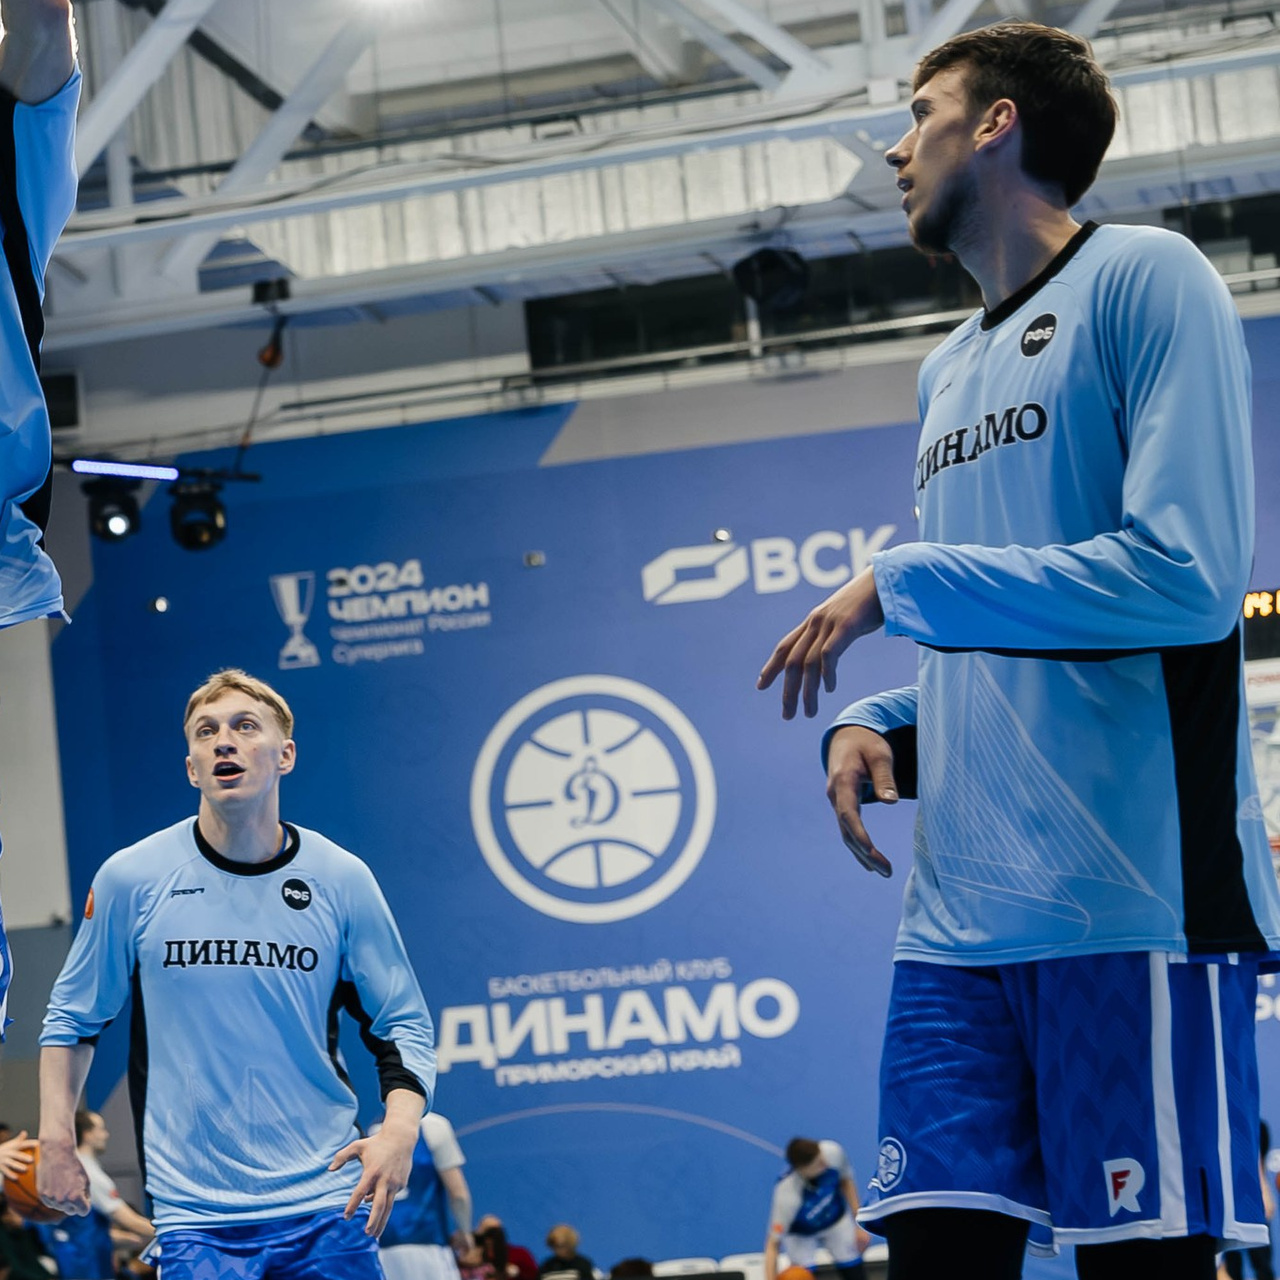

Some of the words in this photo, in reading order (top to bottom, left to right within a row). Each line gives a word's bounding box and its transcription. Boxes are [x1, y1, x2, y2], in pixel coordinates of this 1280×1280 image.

[326, 559, 424, 597] 2024
[753, 524, 897, 596] ВСК
[327, 581, 490, 623] ЧЕМПИОН
[284, 887, 310, 902] РФБ
[163, 938, 319, 973] ДИНАМО
[676, 956, 733, 981] КЛУБ
[436, 977, 800, 1074] ДИНАМО
[495, 1048, 668, 1088] ПРИМОРСКИЙ
[670, 1043, 742, 1072] КРАЙ
